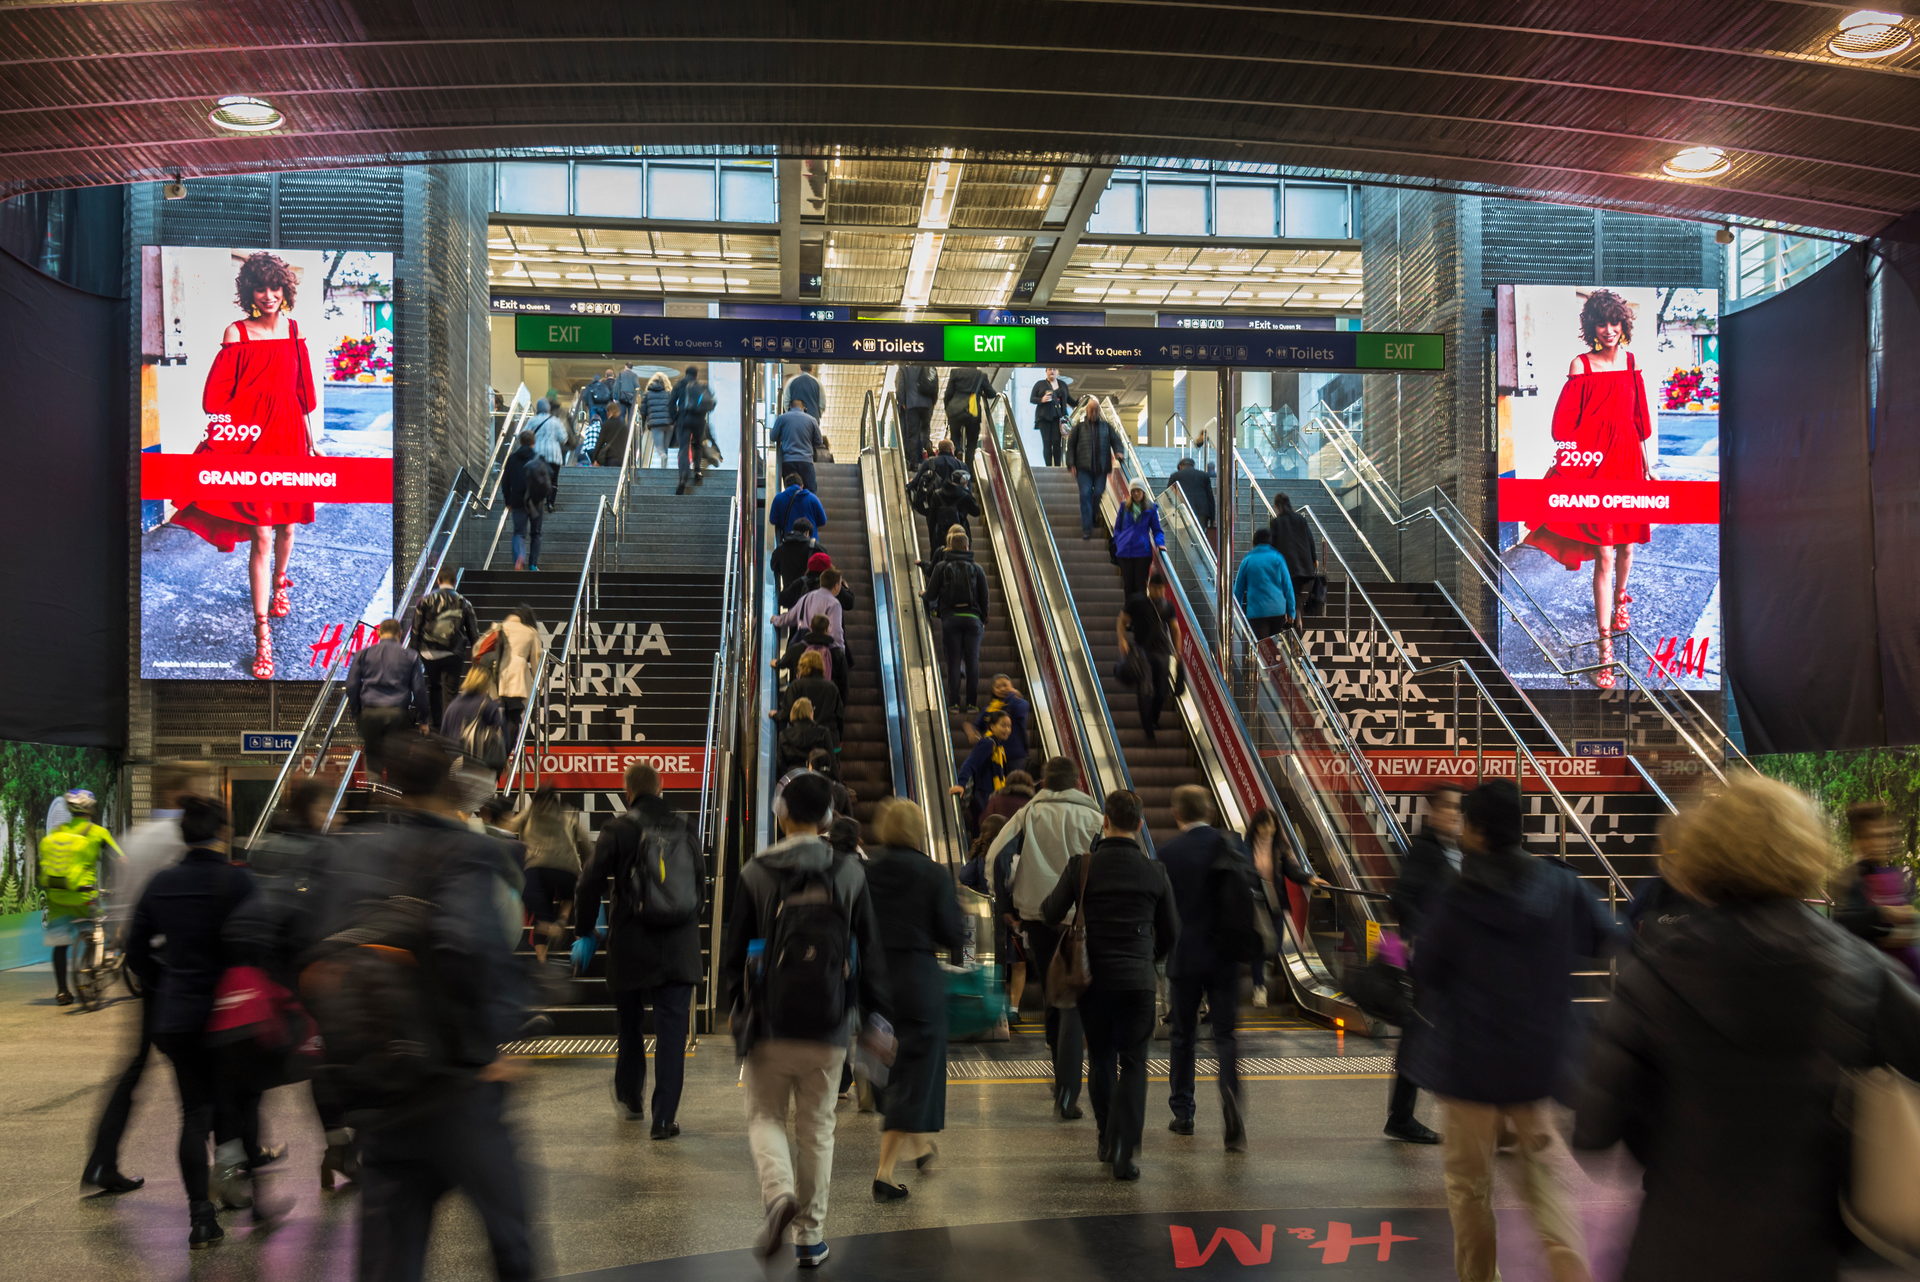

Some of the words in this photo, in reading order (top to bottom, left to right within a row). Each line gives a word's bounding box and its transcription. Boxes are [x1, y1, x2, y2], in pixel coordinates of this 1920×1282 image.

[500, 299, 518, 310] Exit
[1020, 316, 1049, 324] Toilets
[1254, 320, 1271, 330] Exit
[549, 326, 582, 343] EXIT
[644, 333, 670, 348] Exit
[674, 339, 684, 348] to
[685, 338, 712, 348] Queen
[714, 339, 722, 348] St
[878, 338, 924, 353] Toilets
[974, 335, 1006, 353] EXIT
[1066, 342, 1092, 356] Exit
[1096, 347, 1104, 356] to
[1106, 347, 1131, 358] Queen
[1133, 348, 1142, 357] St
[1384, 343, 1414, 360] EXIT
[1290, 347, 1334, 360] Toilets
[206, 414, 231, 423] ress
[213, 424, 261, 442] 29.99
[1556, 441, 1577, 450] ress
[1561, 452, 1603, 466] 29.99
[199, 470, 257, 485] GRAND
[260, 472, 336, 487] OPENING!
[1548, 494, 1600, 508] GRAND
[1602, 494, 1670, 509] OPENING!
[536, 622, 672, 656] YLVIA
[1647, 636, 1710, 680] H&M
[541, 662, 646, 697] ARK
[530, 704, 608, 742] CT
[616, 704, 646, 742] 1.
[274, 739, 293, 749] Lift
[1602, 746, 1618, 756] Lift
[510, 755, 619, 773] VOURITE
[1378, 758, 1424, 775] NEW
[1426, 758, 1531, 776] FAVOURITE
[1534, 758, 1601, 776] STORE.
[1169, 1221, 1419, 1268] H&M
